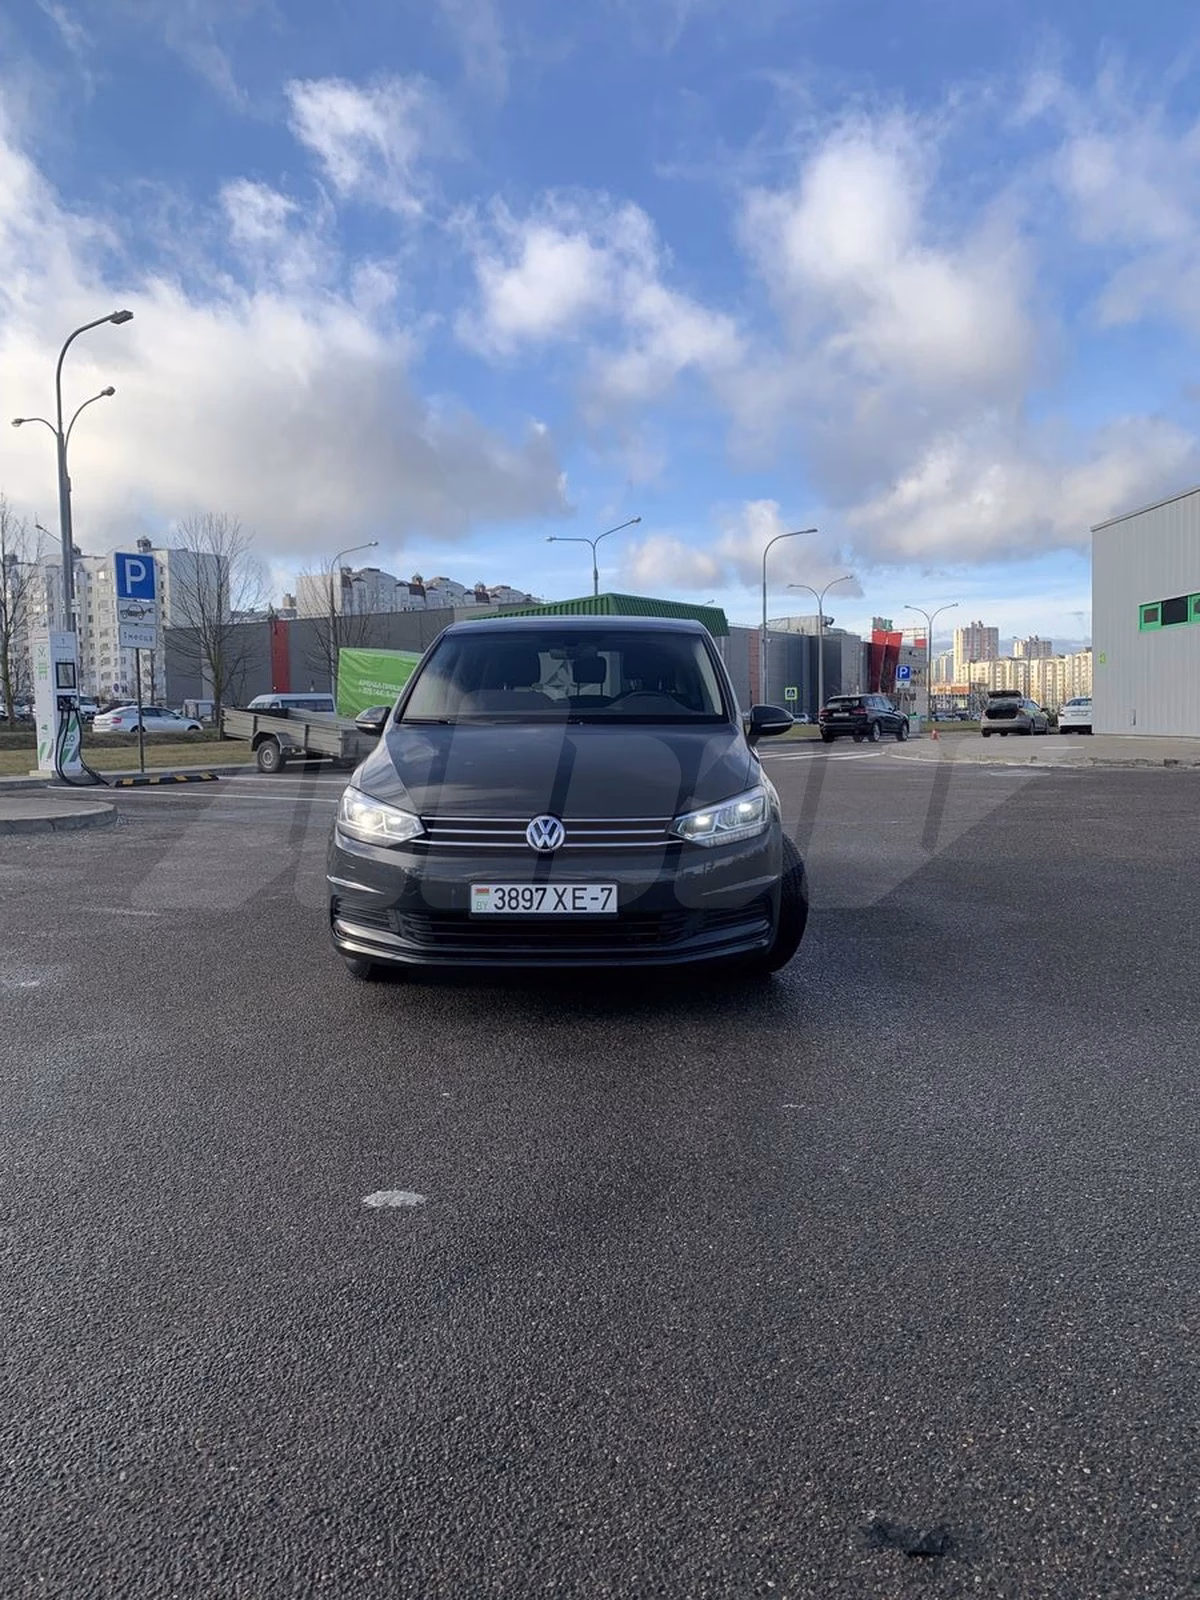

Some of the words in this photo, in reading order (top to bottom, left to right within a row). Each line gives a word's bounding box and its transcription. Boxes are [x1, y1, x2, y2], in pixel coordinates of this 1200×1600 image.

[125, 559, 146, 594] P
[899, 667, 908, 678] P
[476, 900, 488, 911] BY
[494, 887, 547, 911] 3897
[553, 887, 613, 911] XE-7
